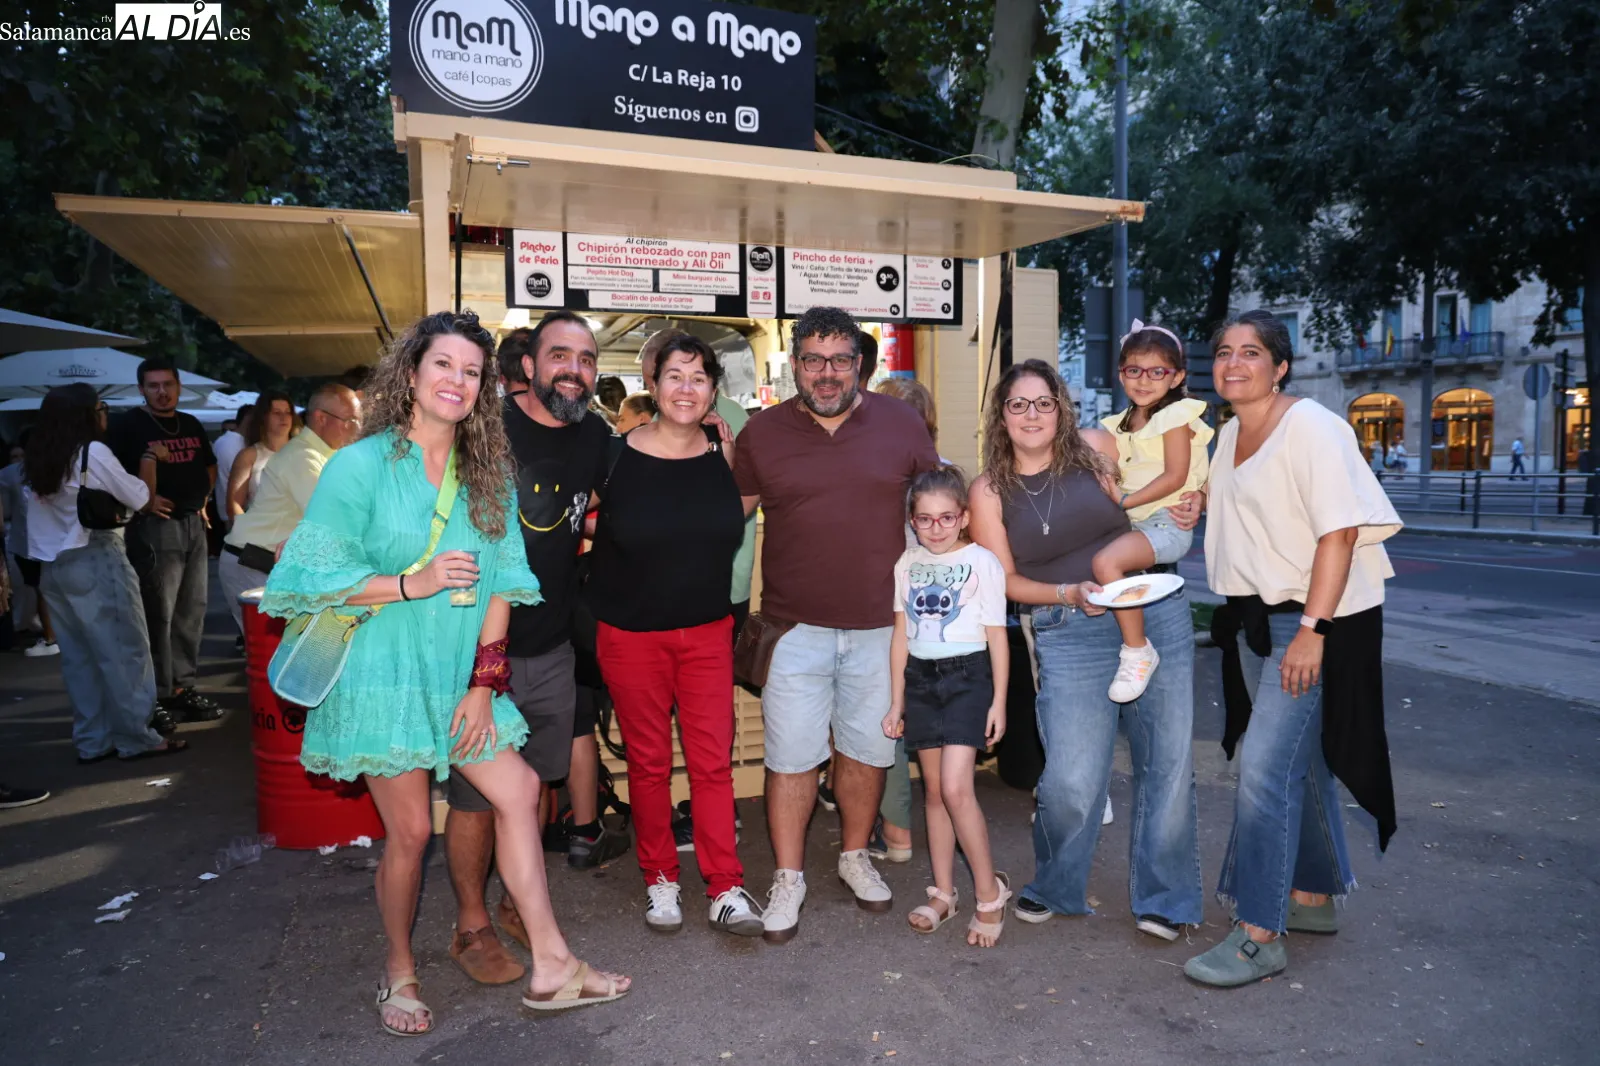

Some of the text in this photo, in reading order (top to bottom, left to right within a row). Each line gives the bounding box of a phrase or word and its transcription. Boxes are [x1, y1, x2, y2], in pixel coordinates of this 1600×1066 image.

[555, 0, 801, 64] Mano a Mano
[432, 48, 522, 68] mano a mano
[444, 70, 512, 86] café copas
[628, 64, 742, 92] C/ La Reja 10
[614, 96, 727, 124] Síguenos en
[520, 242, 556, 253] Pinchos
[578, 242, 627, 254] Chipirón
[631, 246, 684, 257] rebozado
[711, 252, 731, 260] pan
[519, 254, 531, 263] de
[586, 253, 621, 264] recién
[626, 256, 679, 267] horneado
[683, 260, 688, 269] y
[692, 259, 706, 268] Ali
[793, 252, 826, 262] Pincho
[829, 254, 841, 263] de
[844, 255, 865, 264] feria
